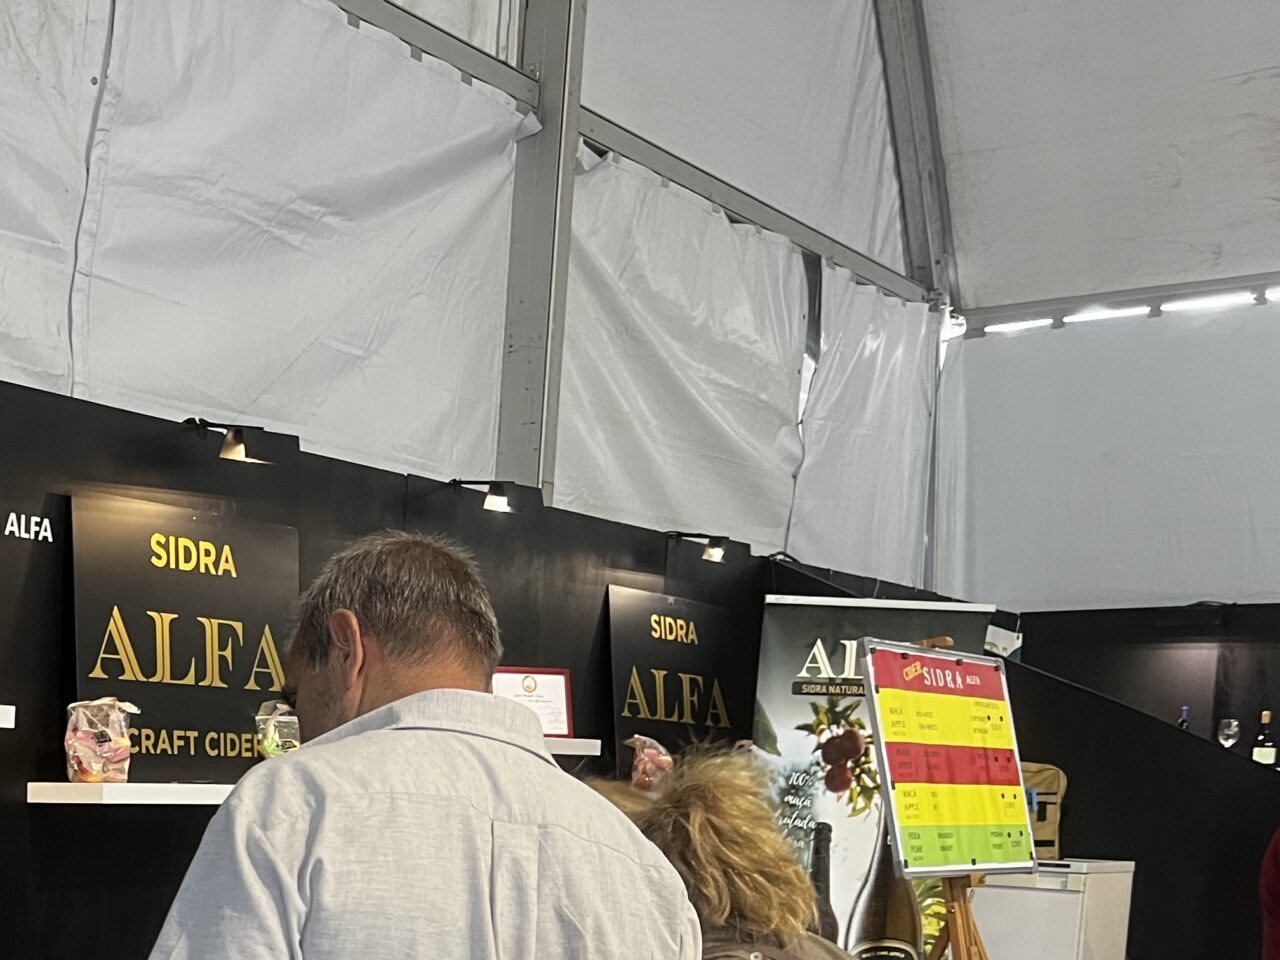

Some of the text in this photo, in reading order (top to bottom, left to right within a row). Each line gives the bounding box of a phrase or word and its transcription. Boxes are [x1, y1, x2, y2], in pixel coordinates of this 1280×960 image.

[4, 511, 54, 543] ALFA
[149, 532, 238, 578] SIDRA
[650, 614, 699, 645] SIDRA
[88, 605, 287, 692] ALFA
[796, 638, 864, 679] AL
[801, 684, 865, 694] SIDRA NATURA
[922, 666, 964, 690] SIDRA
[621, 665, 732, 728] ALFA
[128, 728, 199, 757] CRAFT
[788, 772, 813, 786] 100%
